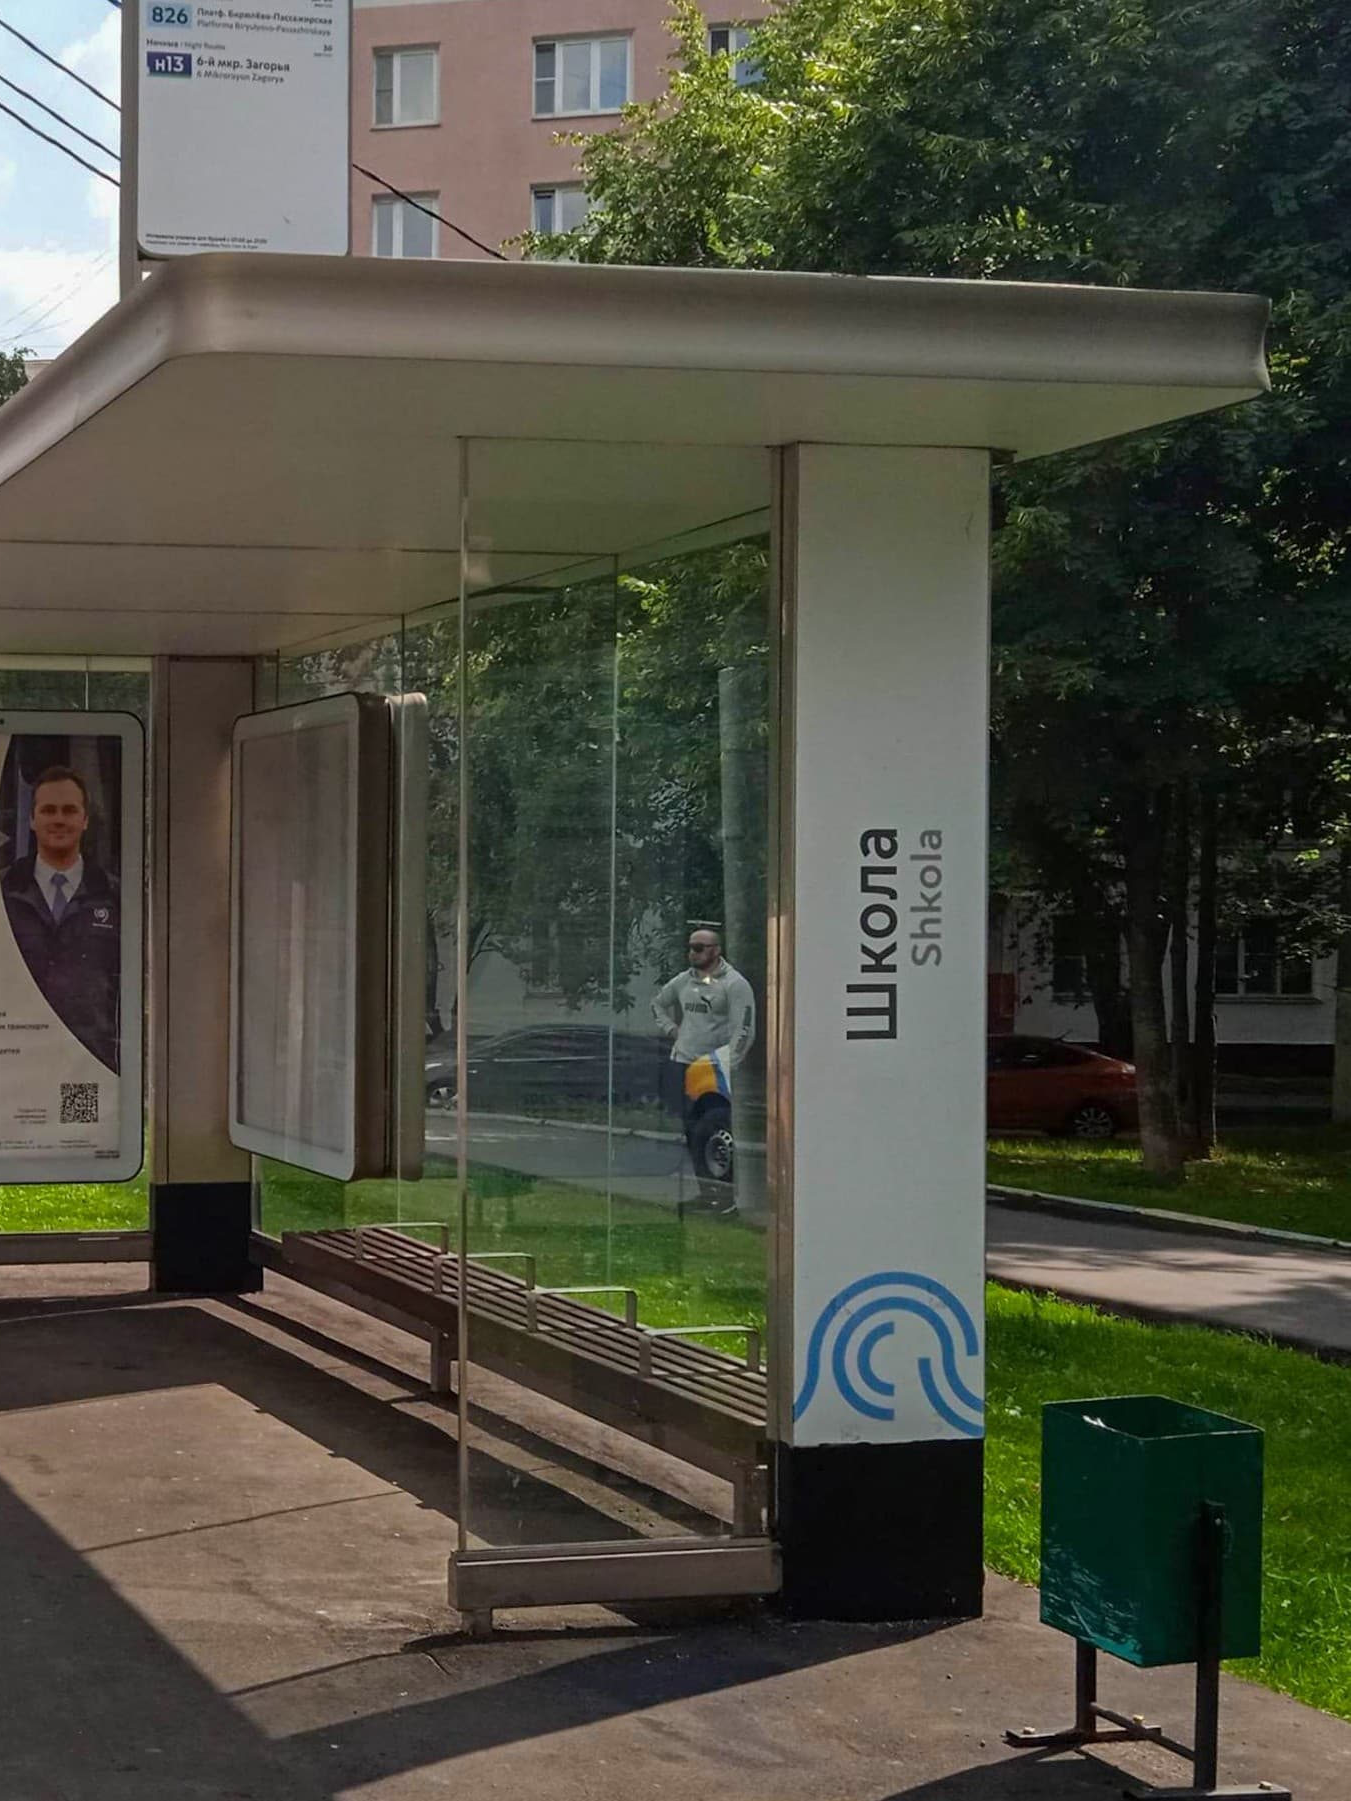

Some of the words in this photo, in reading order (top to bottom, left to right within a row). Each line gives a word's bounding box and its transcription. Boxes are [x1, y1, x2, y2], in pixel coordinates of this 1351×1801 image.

[152, 6, 188, 24] 826
[155, 55, 185, 73] н13
[197, 57, 216, 68] 6-й
[217, 60, 243, 72] мкр.
[247, 59, 290, 74] Загорья
[846, 828, 898, 1040] Школа
[909, 829, 943, 967] Shkola
